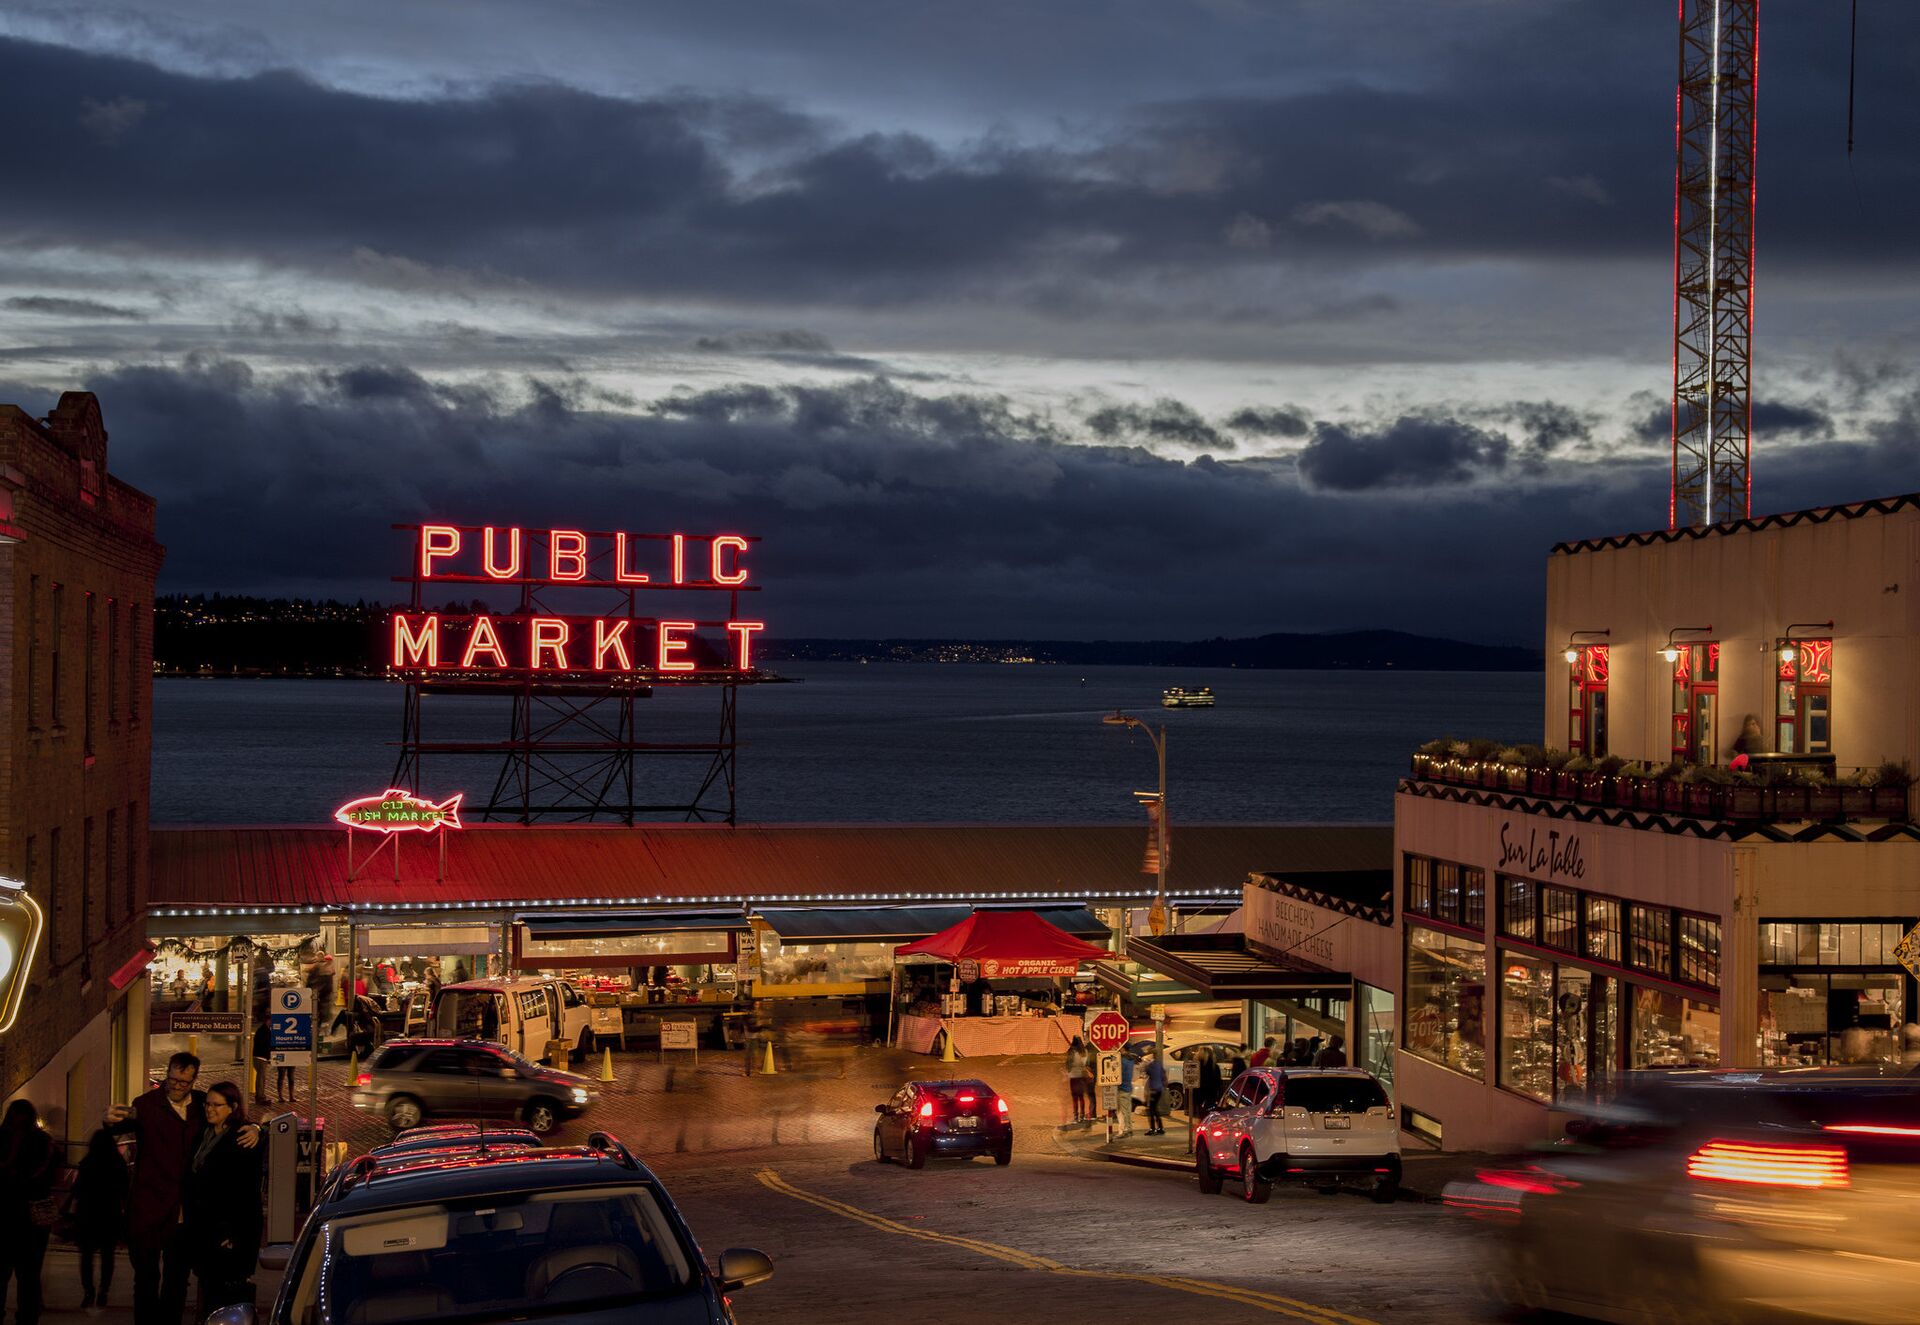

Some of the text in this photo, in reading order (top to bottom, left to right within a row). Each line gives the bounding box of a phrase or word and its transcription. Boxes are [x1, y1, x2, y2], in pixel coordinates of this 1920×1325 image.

[419, 524, 750, 586] PUBLIC
[393, 614, 765, 671] MARKET
[382, 801, 416, 810] CITY
[350, 811, 447, 821] FISH MARKET
[1499, 822, 1585, 878] Sur La Table
[1275, 899, 1315, 930] BEECHER'S
[741, 928, 756, 937] ONE
[1258, 918, 1333, 961] HANDMADE CHEESE
[1050, 966, 1075, 974] CIDER
[286, 994, 298, 1007] P
[284, 1017, 298, 1034] 2
[1092, 1024, 1126, 1040] STOP
[280, 1123, 288, 1132] P
